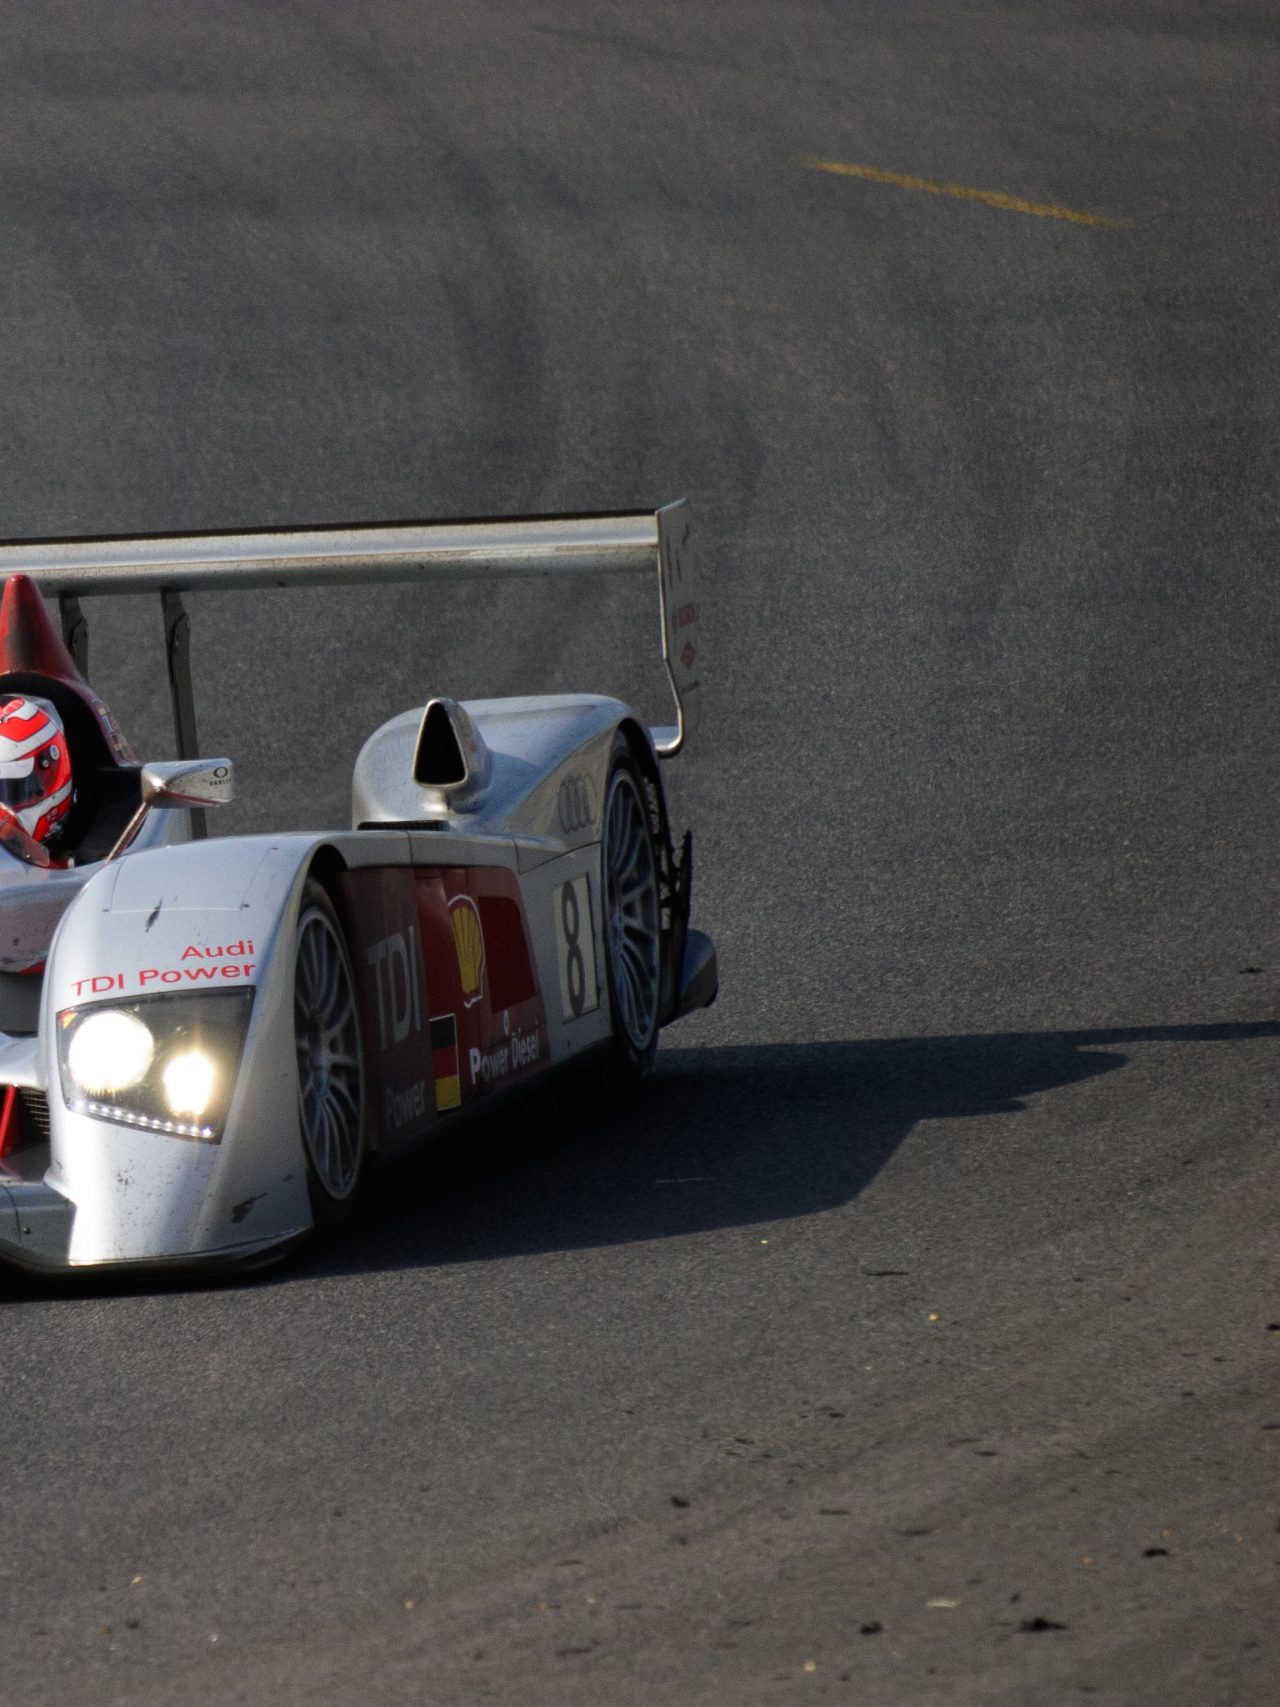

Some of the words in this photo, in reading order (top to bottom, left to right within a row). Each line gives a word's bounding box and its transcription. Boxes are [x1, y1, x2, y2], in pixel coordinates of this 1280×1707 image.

[181, 940, 255, 960] Audi
[560, 880, 585, 1016] 8
[71, 974, 124, 996] TDI
[139, 964, 256, 986] Power
[368, 926, 421, 1050] TDI
[468, 1046, 509, 1086] Power
[511, 1023, 540, 1069] Diesel
